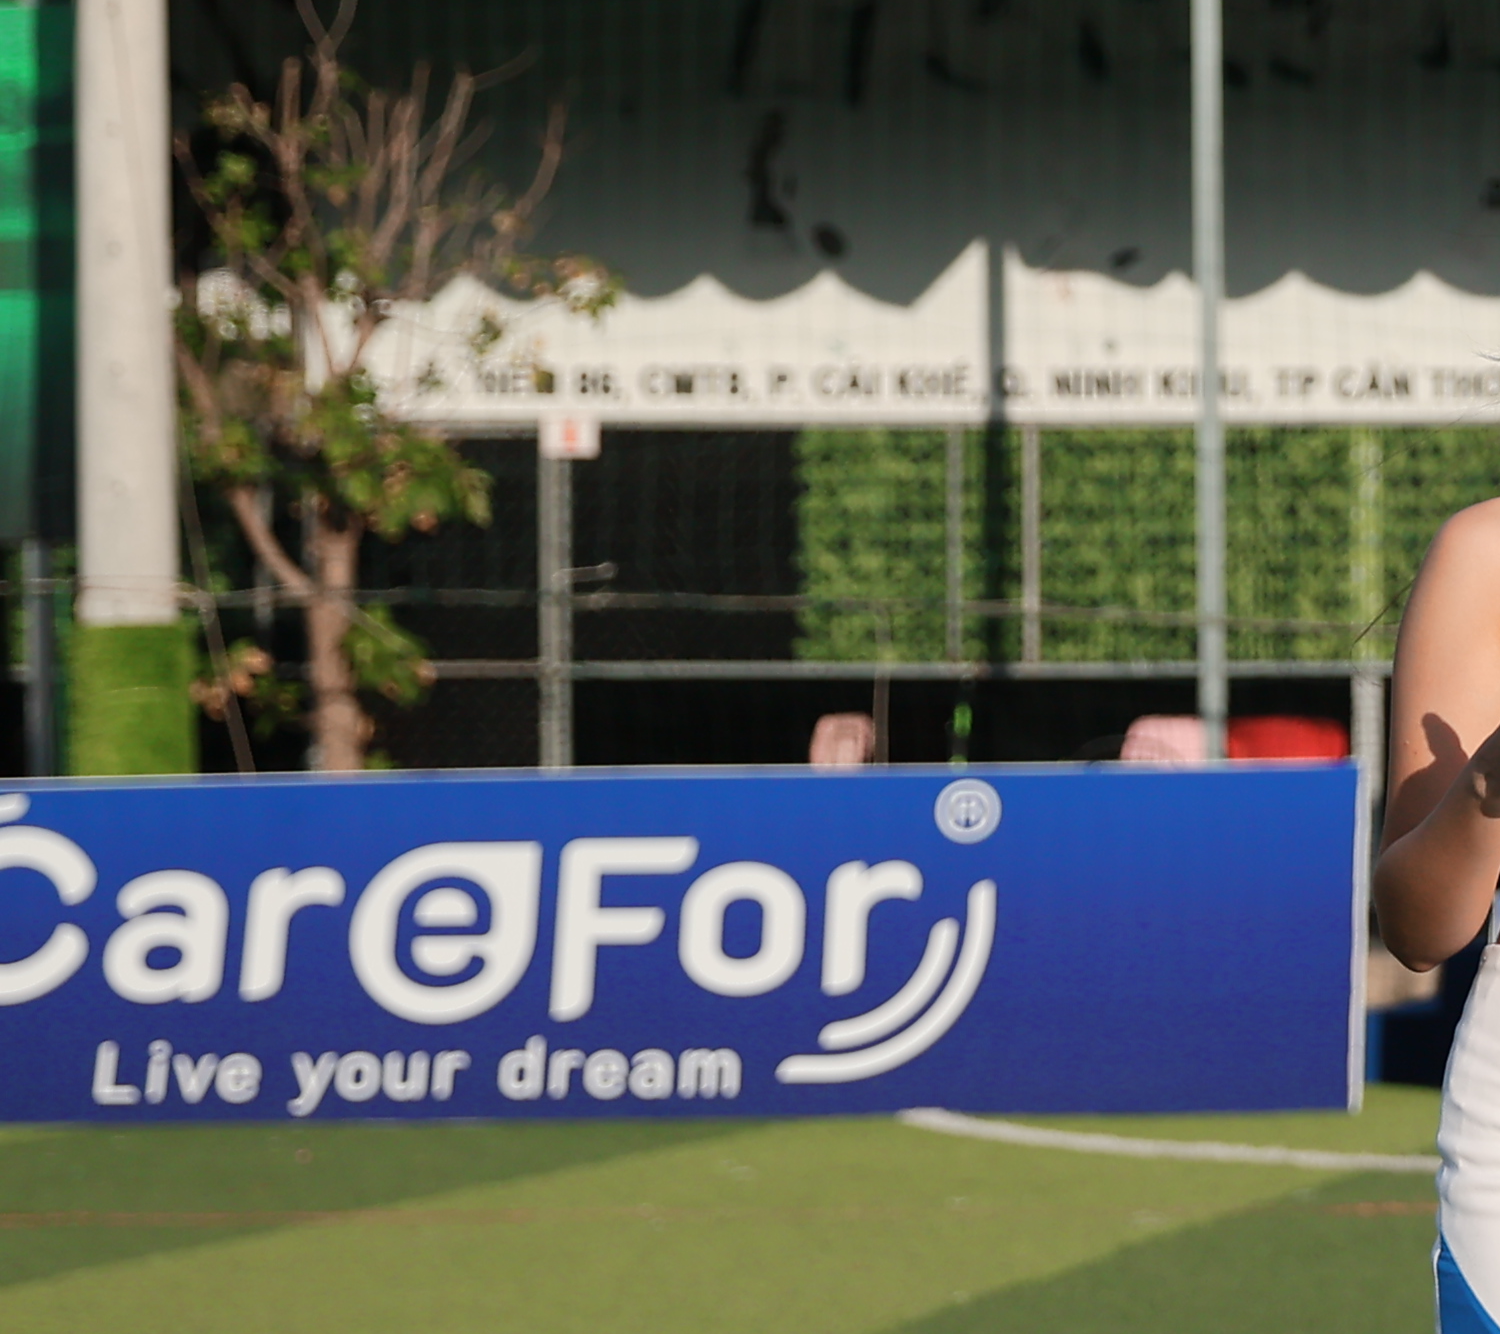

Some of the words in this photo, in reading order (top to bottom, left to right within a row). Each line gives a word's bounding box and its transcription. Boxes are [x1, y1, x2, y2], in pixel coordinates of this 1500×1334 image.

[92, 1037, 261, 1106] Live
[287, 1045, 471, 1117] your
[497, 1033, 743, 1101] dream
